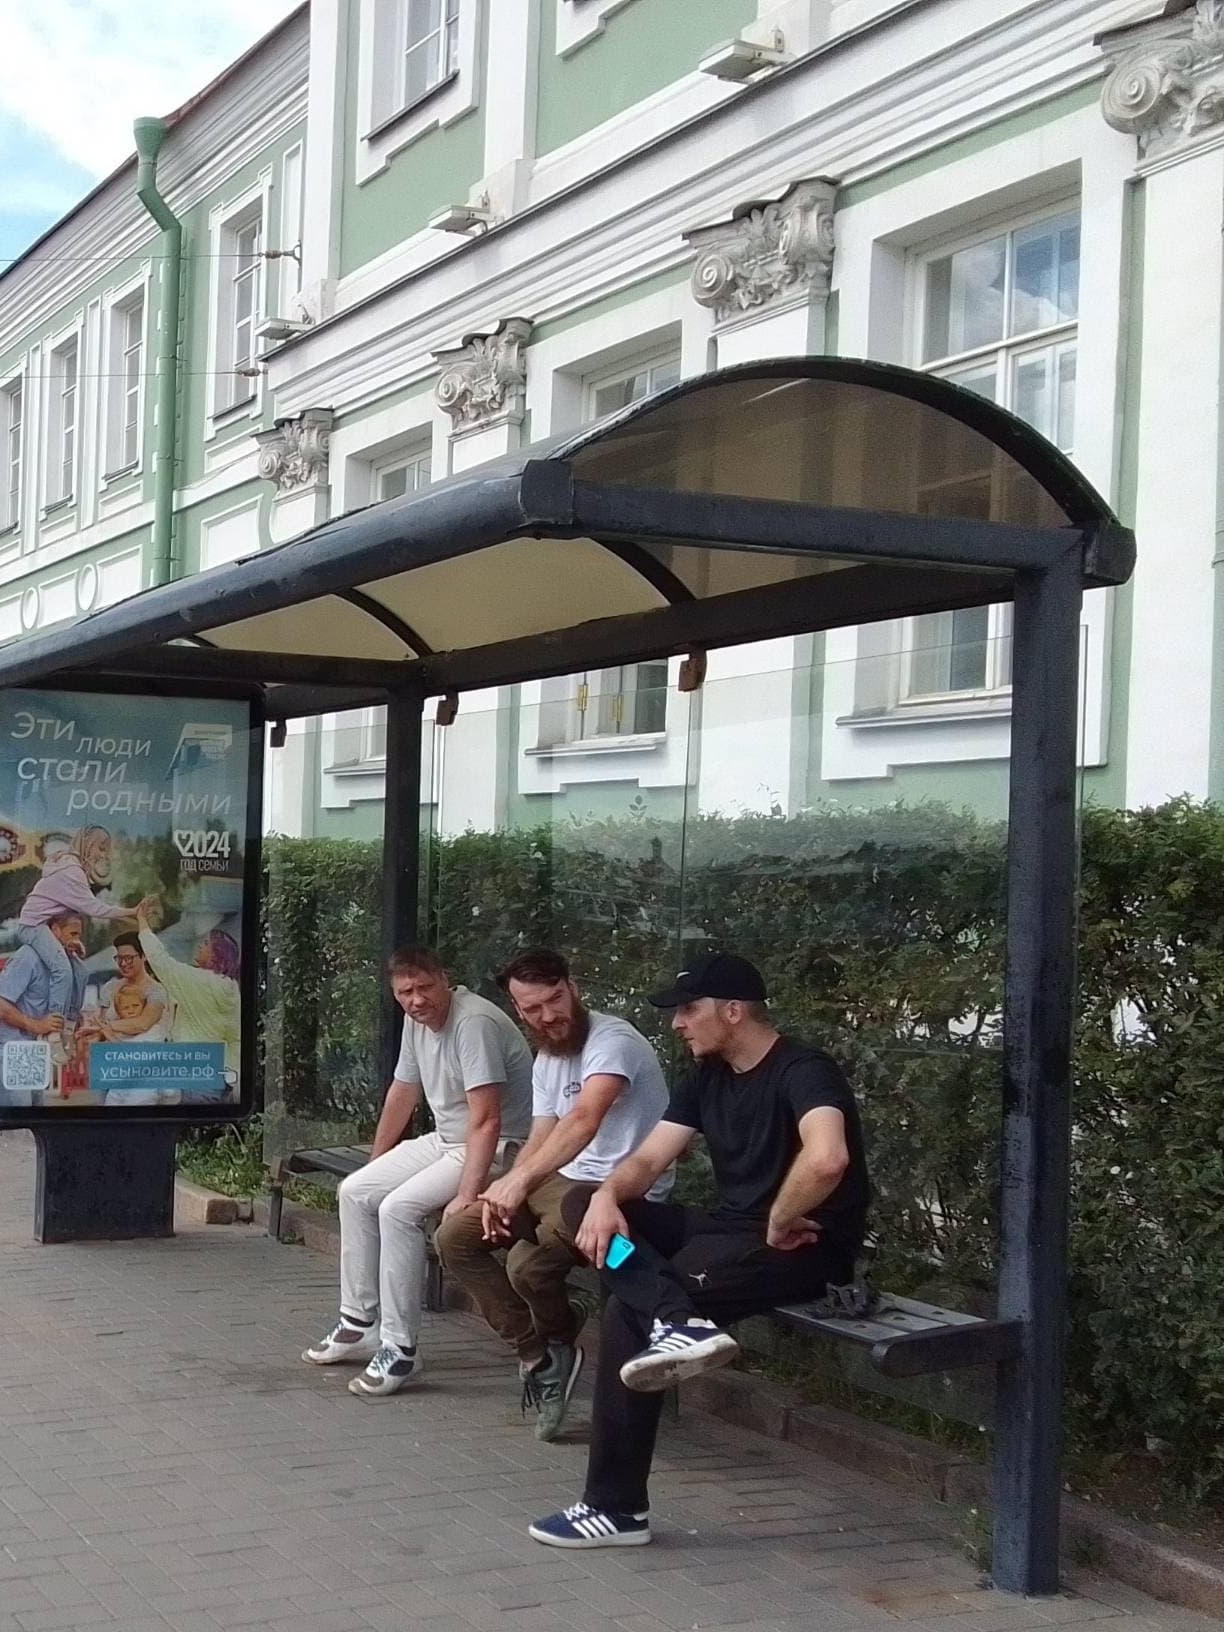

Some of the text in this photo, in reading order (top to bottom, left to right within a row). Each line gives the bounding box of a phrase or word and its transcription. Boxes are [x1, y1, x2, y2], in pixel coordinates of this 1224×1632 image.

[10, 711, 76, 741] Эти
[75, 737, 152, 758] люди
[17, 757, 129, 783] стали
[66, 788, 231, 815] родными
[173, 830, 231, 858] 2024
[104, 1051, 211, 1061] СТАНОВИТЕСЬ И ВЫ
[100, 1064, 215, 1080] усыновите.рф
